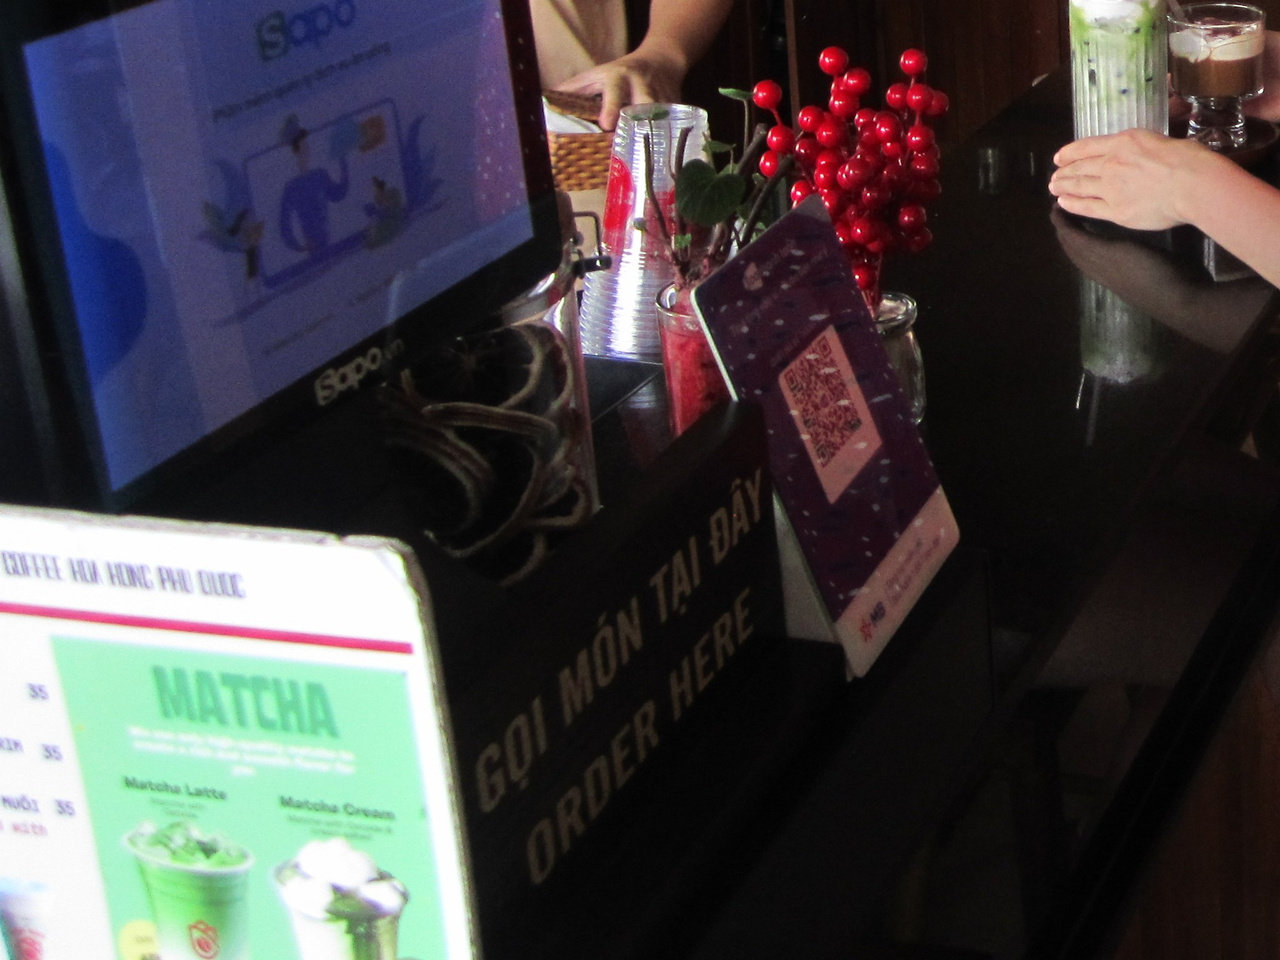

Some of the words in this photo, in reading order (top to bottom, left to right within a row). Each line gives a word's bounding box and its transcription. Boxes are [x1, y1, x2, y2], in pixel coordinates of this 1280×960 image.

[1, 551, 62, 580] COFFEE
[870, 601, 886, 627] MB
[475, 695, 548, 813] GỌI
[558, 596, 643, 727] MÓN
[650, 535, 701, 623] TẠI
[709, 466, 761, 566] ĐÂY
[28, 682, 49, 701] 35
[153, 665, 340, 739] MATCHA
[526, 700, 660, 884] ORDER
[669, 587, 754, 721] HERE
[41, 744, 63, 761] 35
[124, 776, 181, 794] Matcha
[185, 784, 227, 800] Latte
[55, 799, 76, 817] 35
[280, 795, 338, 814] Matcha
[343, 802, 395, 820] Cream
